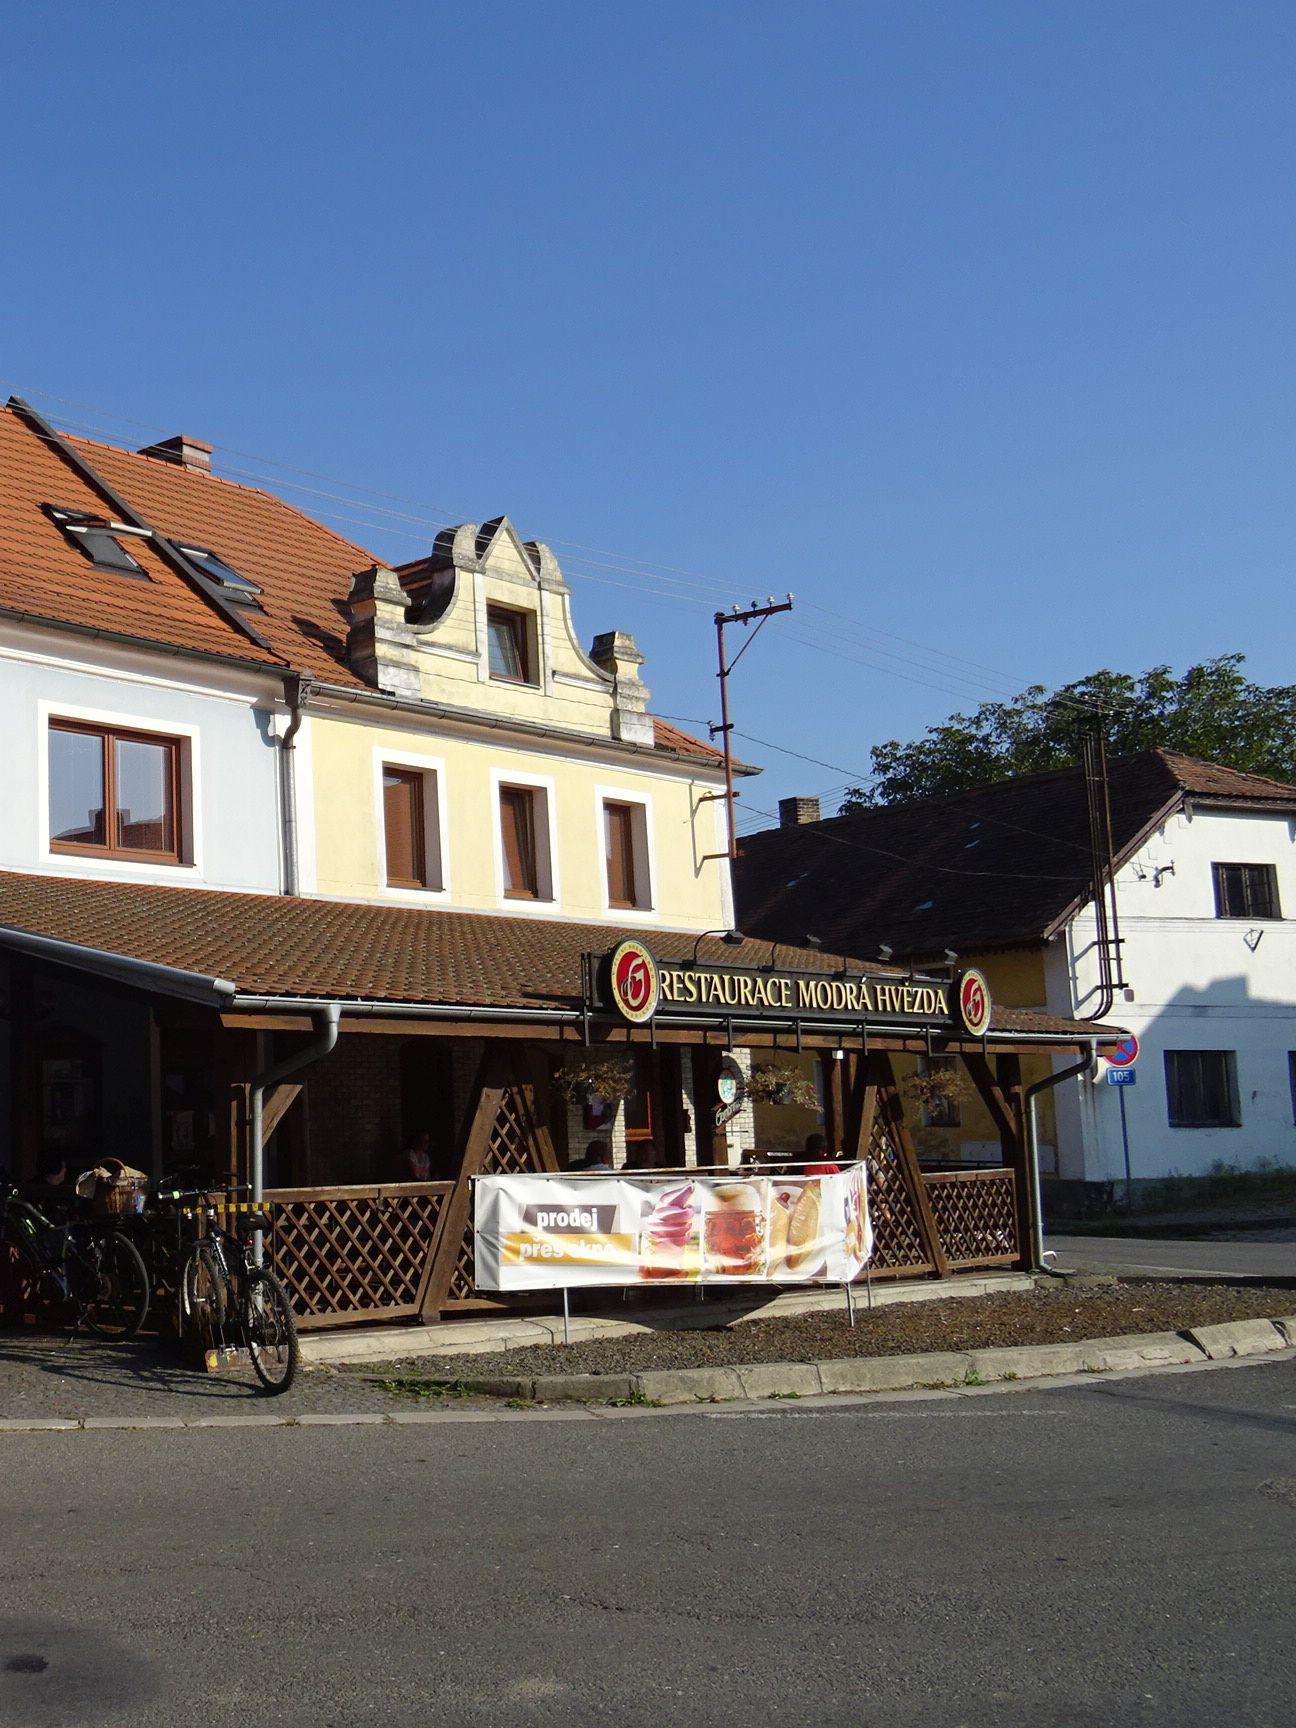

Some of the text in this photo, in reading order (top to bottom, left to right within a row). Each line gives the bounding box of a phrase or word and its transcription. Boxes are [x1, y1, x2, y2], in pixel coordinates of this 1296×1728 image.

[658, 970, 792, 1007] RESTAURACE
[797, 977, 873, 1011] MODRÁ
[874, 982, 949, 1015] HVĚZDA
[1112, 1071, 1130, 1082] 105
[536, 1207, 598, 1232] prodej
